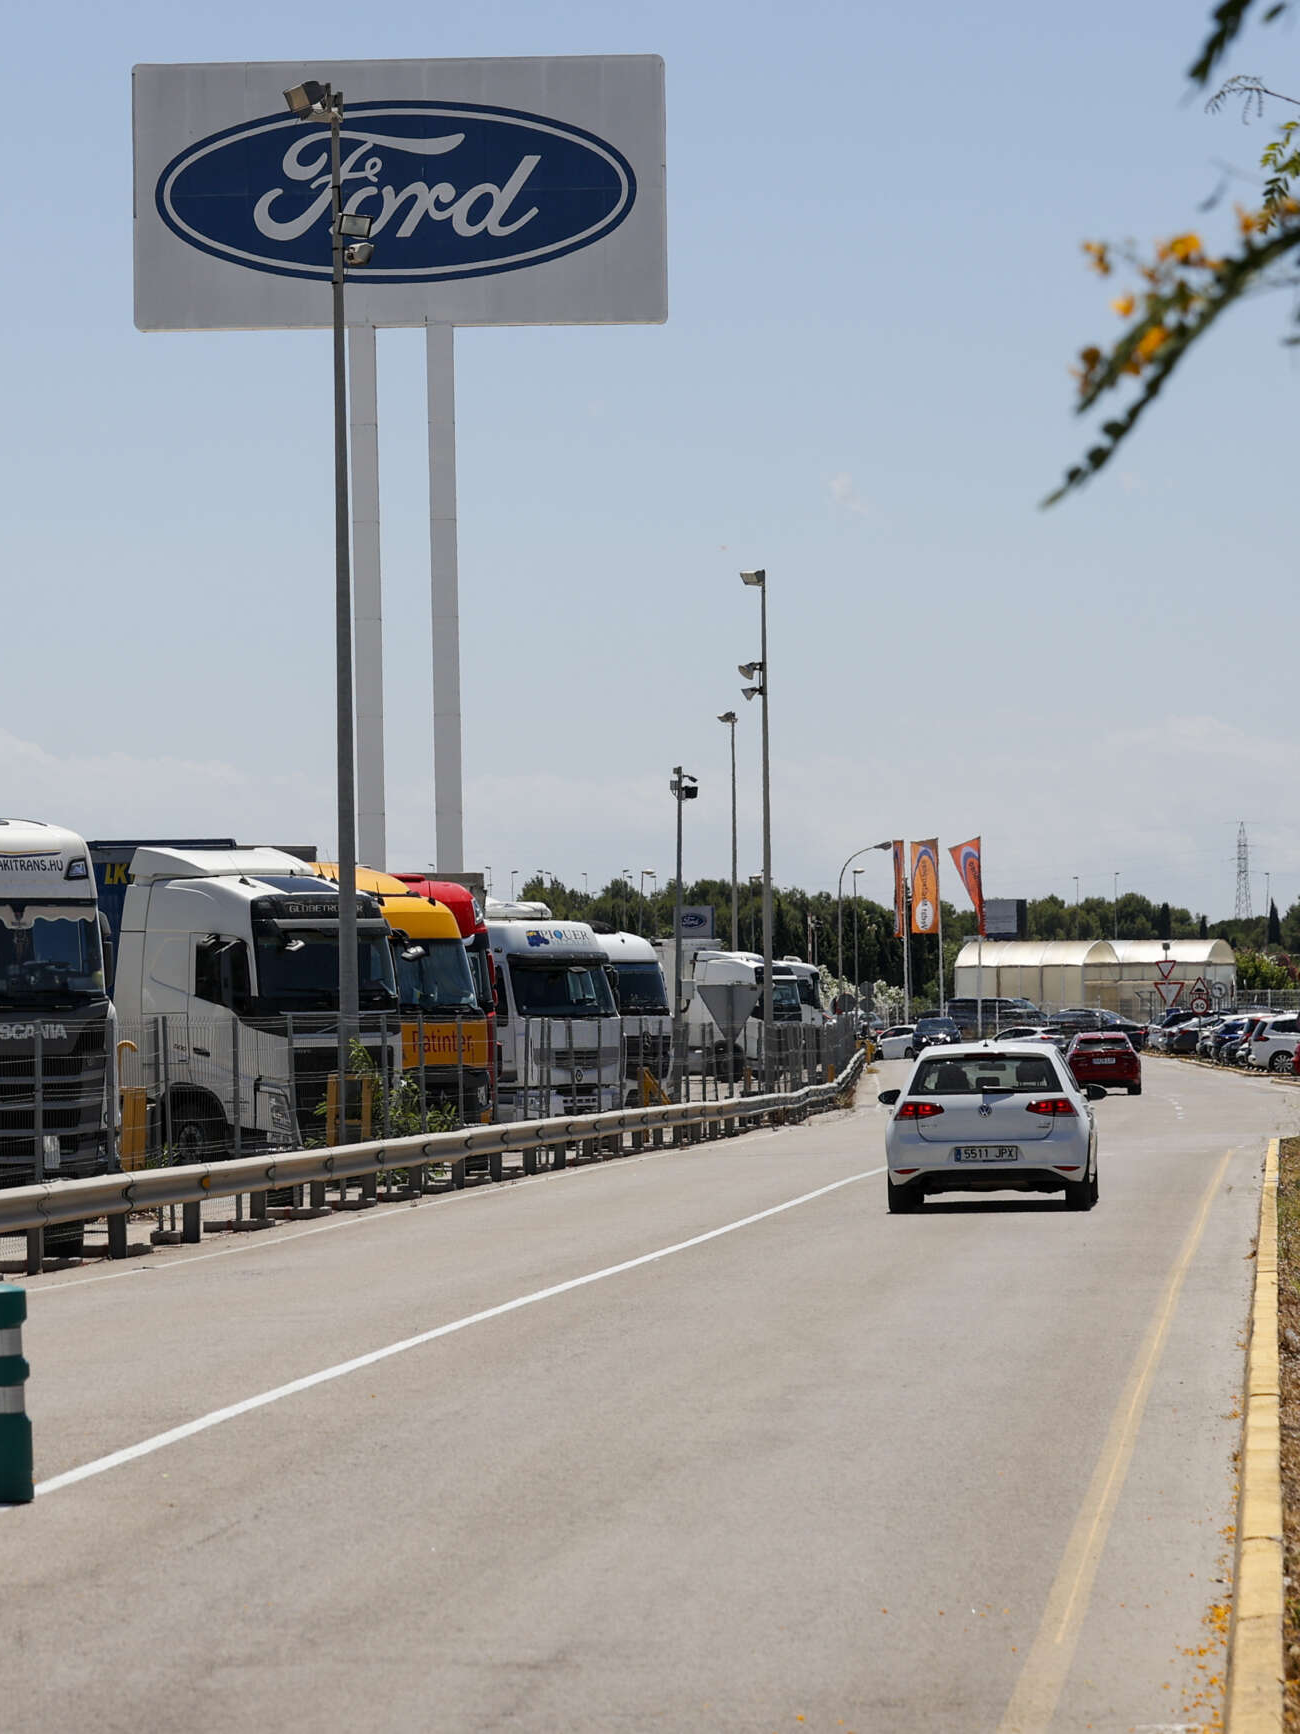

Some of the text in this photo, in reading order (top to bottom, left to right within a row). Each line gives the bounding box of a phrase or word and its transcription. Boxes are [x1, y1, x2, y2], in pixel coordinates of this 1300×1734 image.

[254, 130, 542, 241] Ford
[963, 1148, 1014, 1159] 5511 JPX
